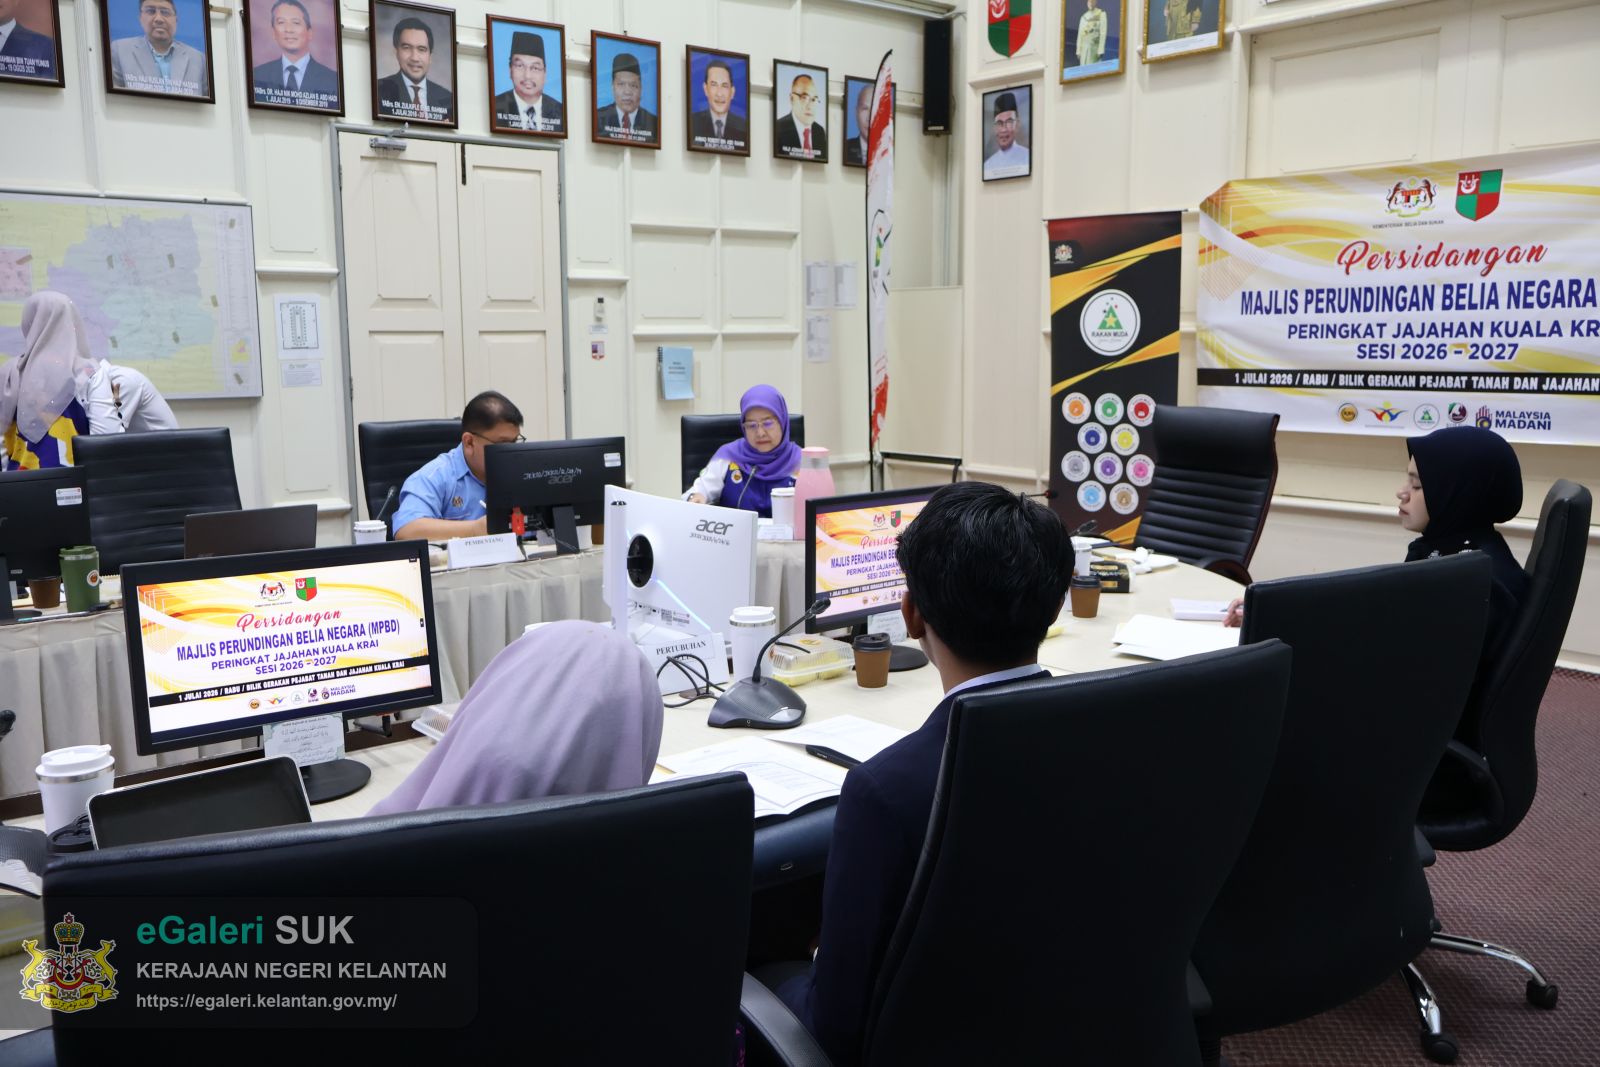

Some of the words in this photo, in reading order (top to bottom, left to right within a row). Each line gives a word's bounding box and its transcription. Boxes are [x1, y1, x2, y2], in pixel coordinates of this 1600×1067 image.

[1337, 240, 1549, 277] Persidangan
[1240, 288, 1299, 316] MAJLIS
[1304, 284, 1436, 314] PERUNDINGAN
[1441, 281, 1500, 311] BELIA
[1506, 278, 1598, 310] NEGARA
[1287, 323, 1388, 340] PERINGKAT
[1391, 321, 1484, 339] JAJAHAN
[1490, 319, 1564, 338] KUALA
[1570, 319, 1600, 338] KR
[1356, 343, 1396, 360] SESI
[1400, 343, 1448, 360] 2026
[1468, 343, 1520, 360] 2027
[1234, 373, 1240, 384] 1
[1241, 373, 1268, 385] JULAI
[1269, 373, 1293, 385] 2026
[1294, 373, 1301, 385] /
[1302, 373, 1329, 386] RABU
[1330, 373, 1336, 387] /
[1338, 373, 1365, 387] BILIK
[1367, 374, 1416, 388] GERAKAN
[1419, 375, 1469, 389] PEJABAT
[1471, 376, 1510, 390] TANAH
[1513, 376, 1539, 391] DAN
[1541, 377, 1600, 392] JAJAHAN
[1495, 410, 1552, 420] MALAYSIA
[1495, 419, 1552, 431] MADANI
[548, 474, 575, 485] acer
[695, 519, 734, 536] acer
[464, 537, 504, 547] PEMBENTANG
[830, 555, 851, 569] MAJLIS
[850, 551, 888, 566] PERUNDINGAN
[846, 565, 875, 576] PERINGKAT
[867, 573, 878, 581] SESI
[236, 609, 342, 633] Persidangan
[176, 642, 217, 662] MAJLIS
[219, 632, 294, 656] PERUNDINGAN
[296, 628, 325, 645] BELIA
[327, 623, 367, 641] NEGARA
[368, 618, 400, 639] (MPBD)
[656, 640, 706, 655] PERTUBUHAN
[211, 654, 271, 671] PERINGKAT
[273, 647, 320, 662] JAJAHAN
[322, 642, 355, 655] KUALA
[356, 639, 379, 650] KRAI
[255, 664, 277, 675] SESI
[279, 660, 304, 672] 2026
[313, 655, 337, 667] 2027
[178, 694, 183, 702] 1
[184, 692, 202, 701] JULAI
[203, 689, 219, 698] 2026
[224, 685, 241, 695] RABU
[246, 683, 262, 691] BILIK
[263, 678, 290, 689] GERAKAN
[291, 674, 316, 685] PEJABAT
[316, 671, 335, 681] TANAH
[336, 669, 348, 678] DAN
[348, 665, 373, 676] JAJAHAN
[374, 662, 392, 672] KUALA
[392, 661, 405, 669] KRAI
[330, 684, 356, 692] MALAYSIA
[330, 688, 356, 697] MADANI
